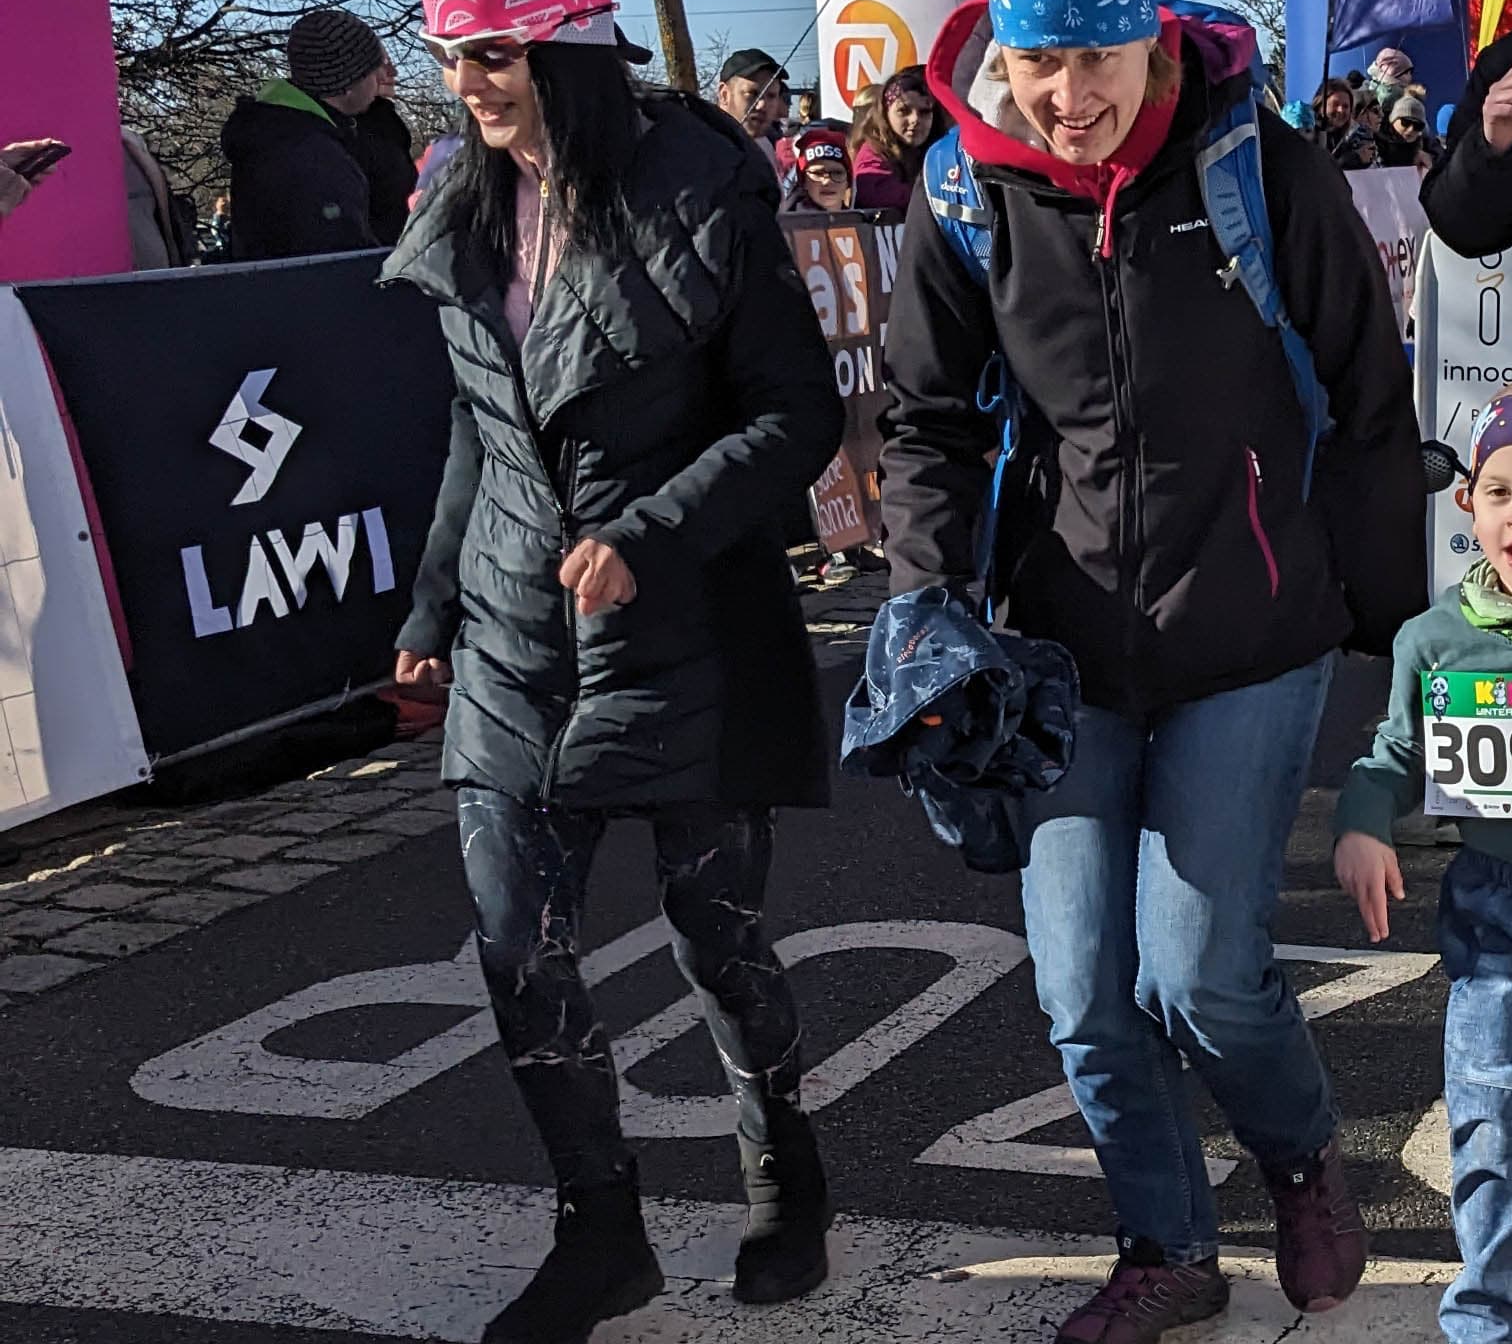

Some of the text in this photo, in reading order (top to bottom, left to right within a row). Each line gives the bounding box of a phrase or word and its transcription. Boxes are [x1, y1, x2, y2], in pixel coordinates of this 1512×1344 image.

[805, 142, 844, 161] BOSS
[940, 182, 969, 195] deuter
[180, 507, 396, 638] LAWI
